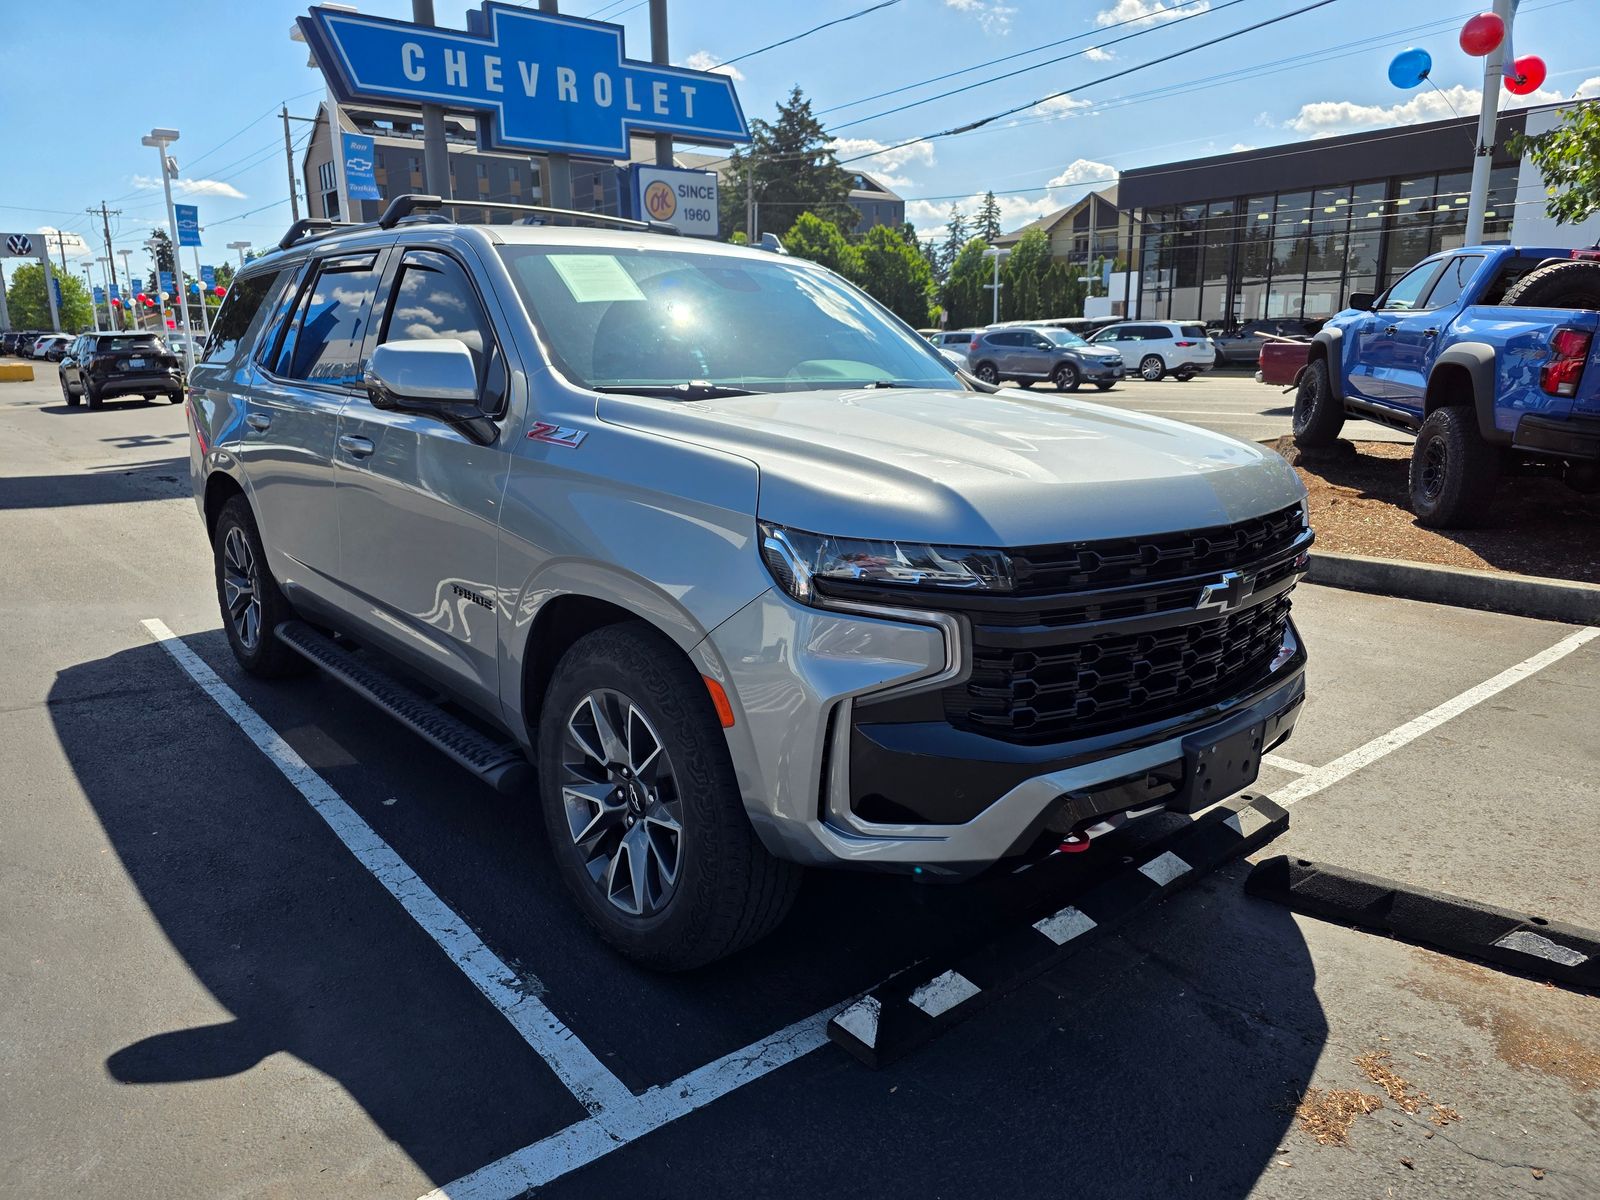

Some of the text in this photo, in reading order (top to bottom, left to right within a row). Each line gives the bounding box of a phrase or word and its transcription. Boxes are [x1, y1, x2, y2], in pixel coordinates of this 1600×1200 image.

[401, 42, 697, 119] CHEVROLET
[350, 142, 368, 151] Ron
[678, 184, 714, 200] SINCE
[650, 188, 672, 213] OK
[684, 208, 711, 221] 1960
